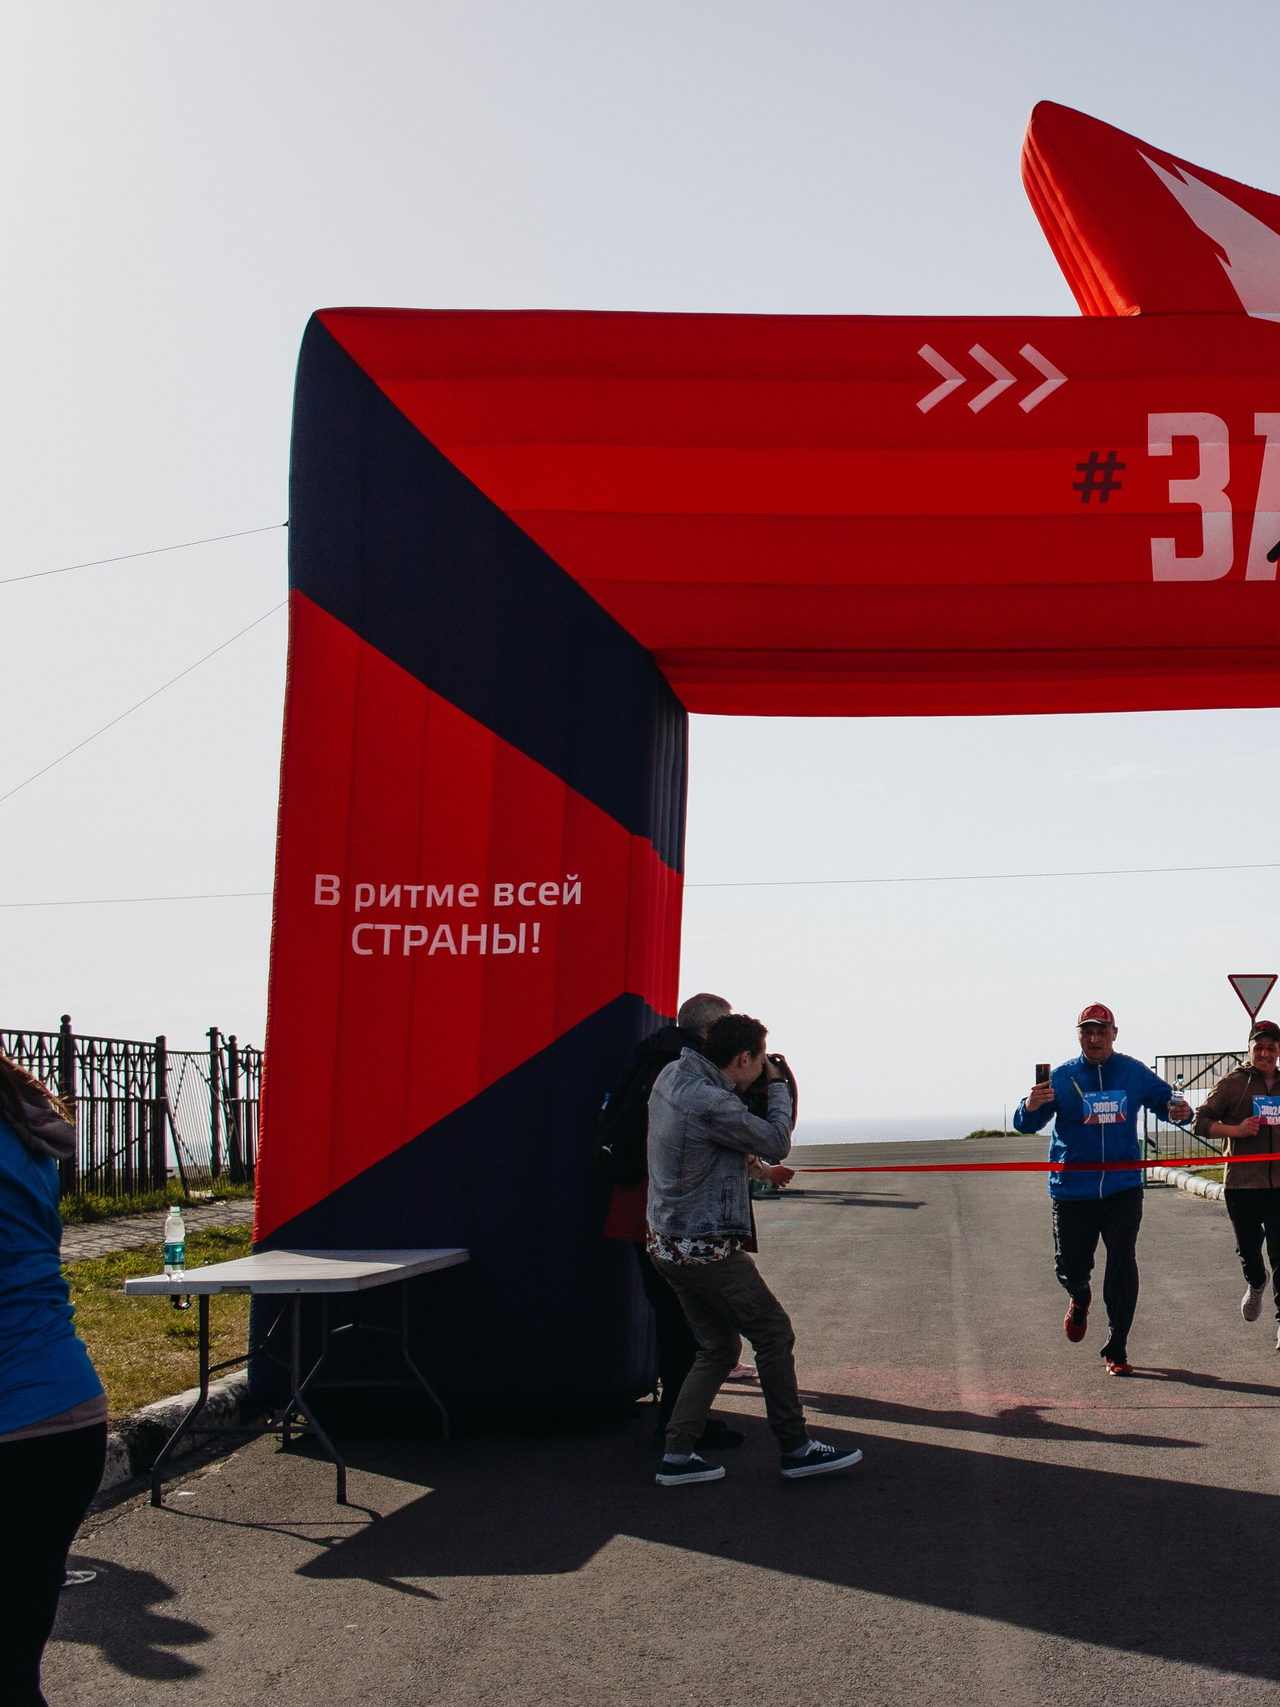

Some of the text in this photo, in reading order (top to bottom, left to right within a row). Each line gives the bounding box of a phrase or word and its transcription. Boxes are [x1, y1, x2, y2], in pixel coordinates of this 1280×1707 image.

[314, 873, 583, 913] В ритме всей
[351, 921, 542, 956] СТРАНЫ!
